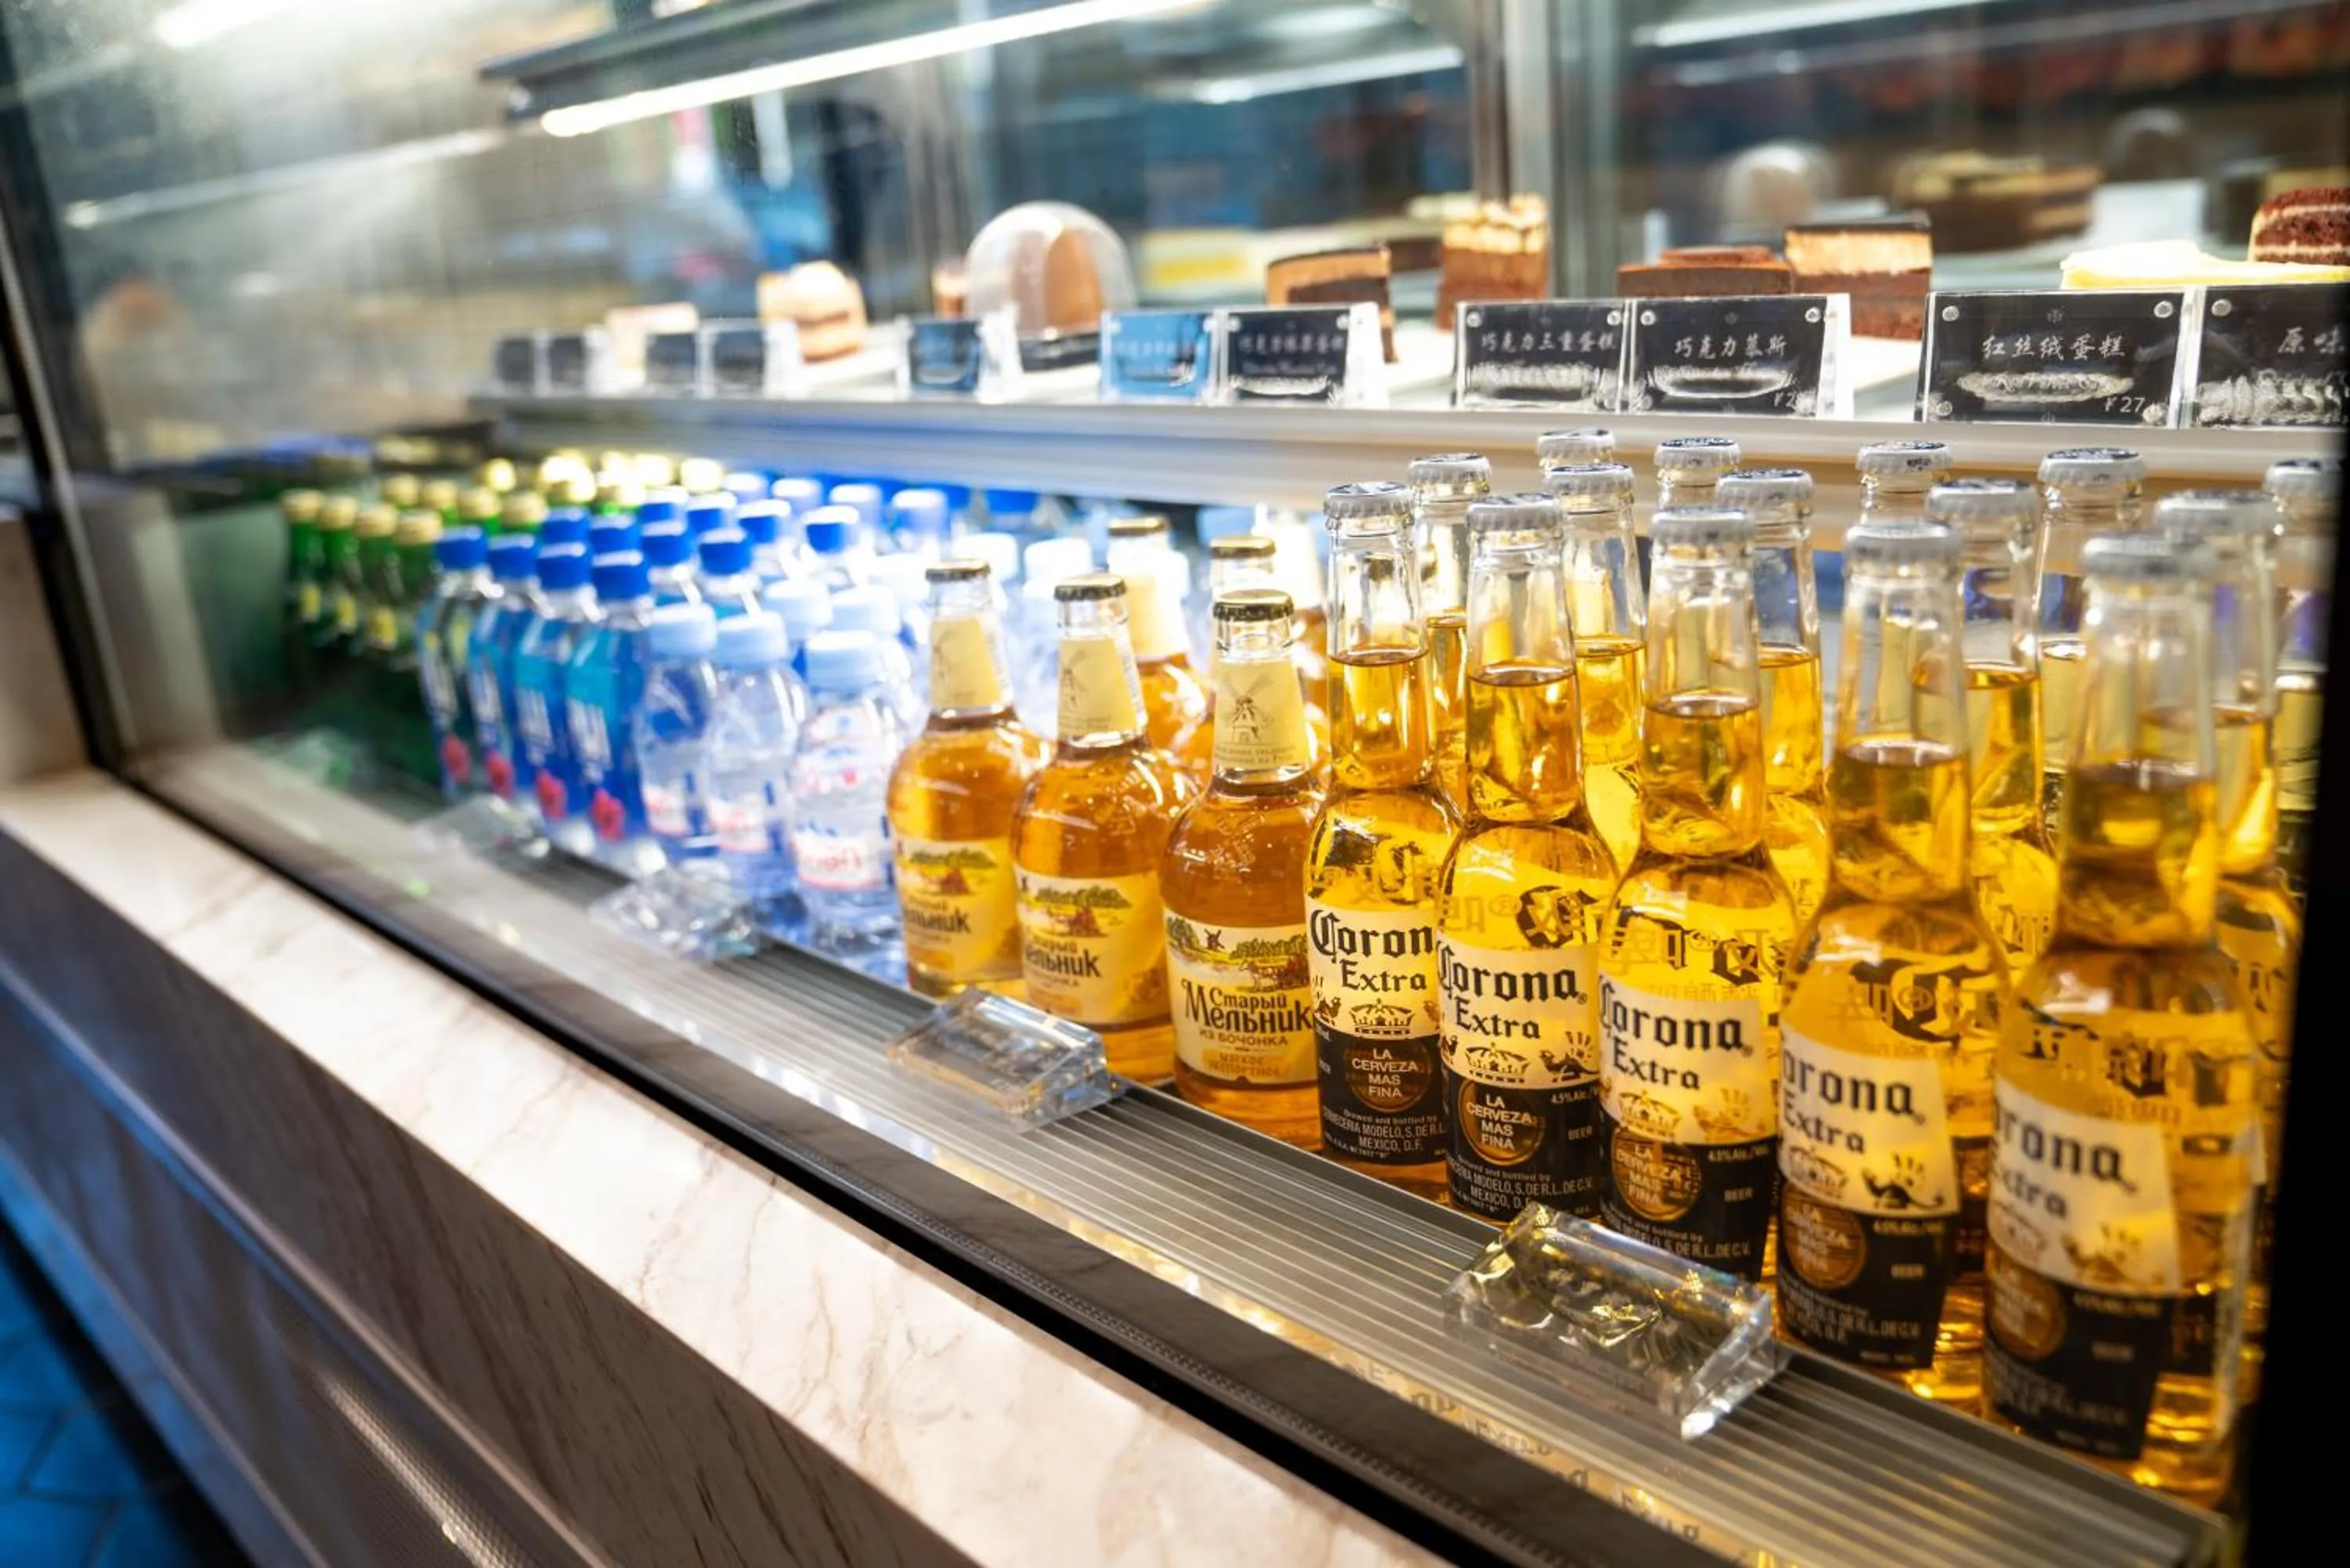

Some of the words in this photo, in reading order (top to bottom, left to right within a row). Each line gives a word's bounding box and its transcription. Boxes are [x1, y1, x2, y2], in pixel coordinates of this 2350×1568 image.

[1982, 332, 2126, 361] 红丝绒蛋糕
[1311, 909, 1433, 963] Coron
[1340, 959, 1427, 992] Extra
[1181, 978, 1313, 1034] Мельник
[1209, 986, 1287, 1014] Старый
[1454, 995, 1541, 1039] Extra
[1351, 1058, 1418, 1073] CERVEZA
[1372, 1048, 1392, 1060] LA
[1613, 1034, 1700, 1090] Extra
[1368, 1074, 1401, 1085] MAS
[1368, 1086, 1403, 1097] FINA
[1783, 1050, 1913, 1116] orona
[1485, 1093, 1506, 1108] LA
[1466, 1102, 1532, 1125] CERVEZA
[1481, 1120, 1513, 1137] MAS
[1480, 1135, 1516, 1151] FINA
